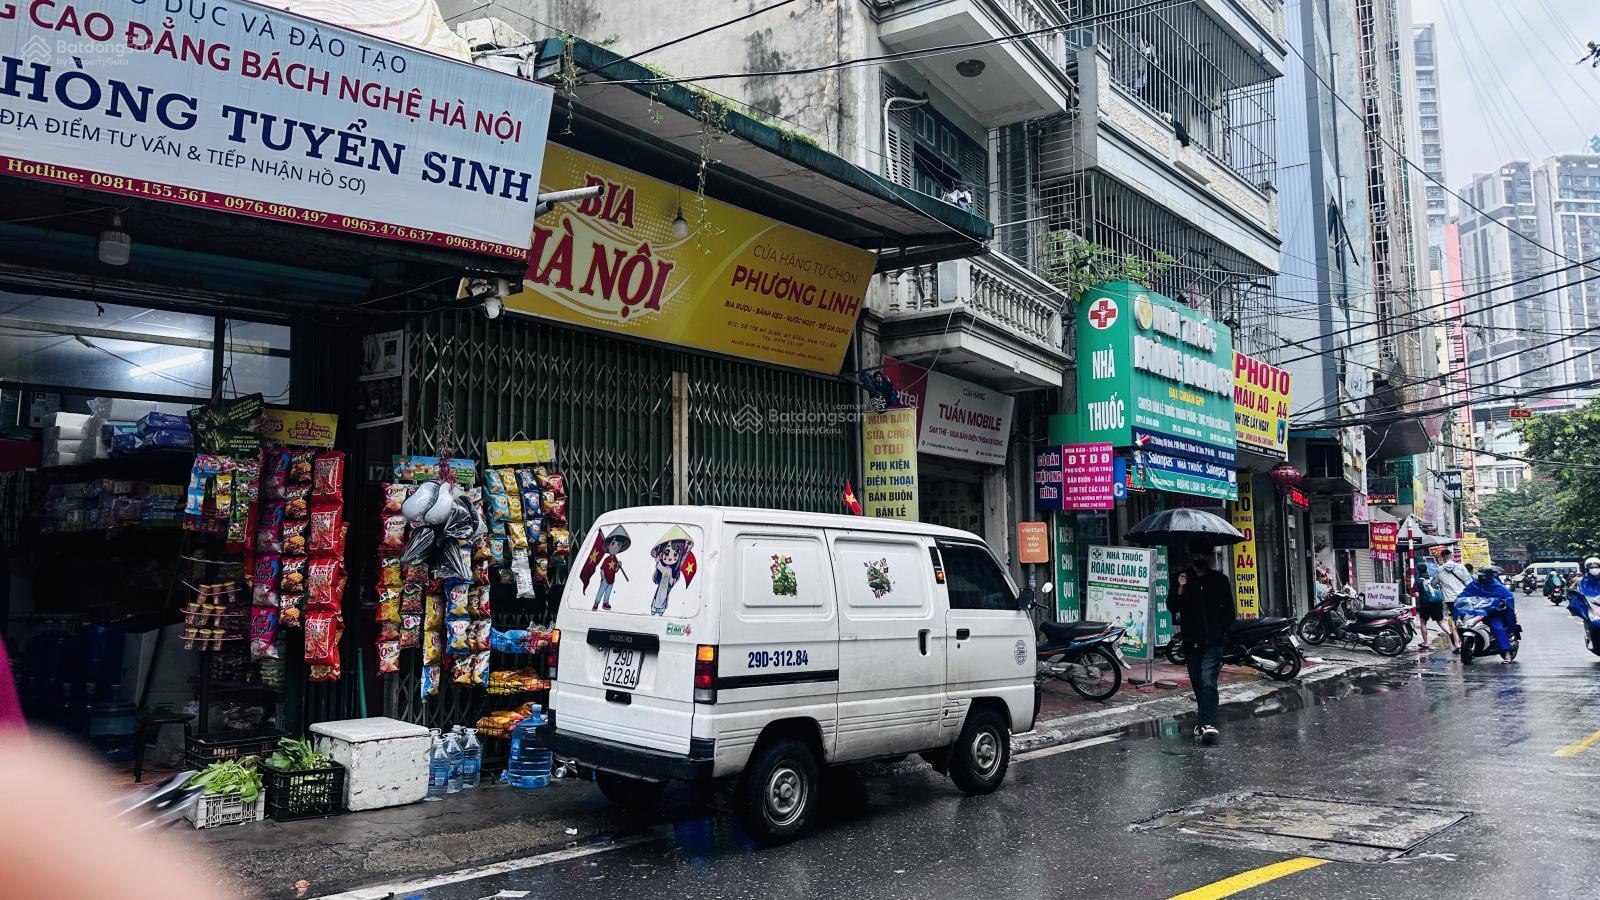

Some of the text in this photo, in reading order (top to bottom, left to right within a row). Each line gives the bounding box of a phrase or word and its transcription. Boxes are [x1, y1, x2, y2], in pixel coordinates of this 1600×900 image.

[241, 13, 275, 40] VÀ
[289, 27, 345, 57] ĐÀO
[358, 45, 406, 74] TẠO
[30, 0, 114, 41] CAO
[126, 17, 230, 71] ĐẲNG
[241, 49, 330, 95] BÁCH
[339, 74, 422, 122] NGHỆ
[430, 98, 466, 129] HÀ
[475, 111, 522, 144] NỘI
[45, 118, 100, 142] ĐIỂM
[107, 129, 136, 147] TƯ
[141, 135, 181, 157] VẤN
[187, 145, 201, 161] &
[207, 149, 246, 169] TIẾP
[251, 159, 302, 181] NHẬN
[308, 167, 334, 186] HỒ
[338, 178, 366, 195] SƠ)
[222, 105, 405, 175] TUYỂN
[421, 151, 532, 202] SINH
[7, 160, 84, 183] Hotline:
[90, 173, 208, 203] 0981.155.561
[224, 197, 328, 224] 0976.980.497
[342, 217, 433, 241] 0965.476.637
[445, 234, 527, 259] 0963.678.994
[577, 175, 635, 229] BIA
[753, 244, 778, 262] CỬA
[579, 243, 674, 319] NỘI
[731, 264, 861, 317] PHƯƠNG LINH
[1092, 343, 1116, 380] NHÀ
[1235, 352, 1289, 396] PHOTO
[1087, 391, 1125, 432] THUỐC
[1234, 384, 1255, 410] MÀU
[1277, 400, 1287, 420] A4
[867, 414, 888, 425] MUA
[938, 399, 1001, 431] TUẤN MOBILE
[310, 430, 332, 439] ngon
[870, 458, 910, 473] PHỤ KIỆN
[1148, 451, 1226, 478] Salonpas NHÀ THUỐC Salonpas
[866, 475, 914, 488] ĐIỆN THOẠI
[896, 504, 906, 517] LẺ
[1061, 554, 1073, 570] CHO
[1106, 550, 1143, 562] NHÀ THUỐC
[1236, 554, 1254, 569] A4
[1091, 559, 1116, 576] HOÀNG
[1117, 564, 1136, 578] LOAN
[1138, 566, 1147, 579] 68
[1063, 578, 1074, 599] QUÝ
[1379, 593, 1395, 601] Trang
[1060, 606, 1079, 623] KHÁCH
[614, 649, 633, 666] 29D
[747, 649, 809, 669] 29D-312.84
[604, 667, 636, 686] 312.84
